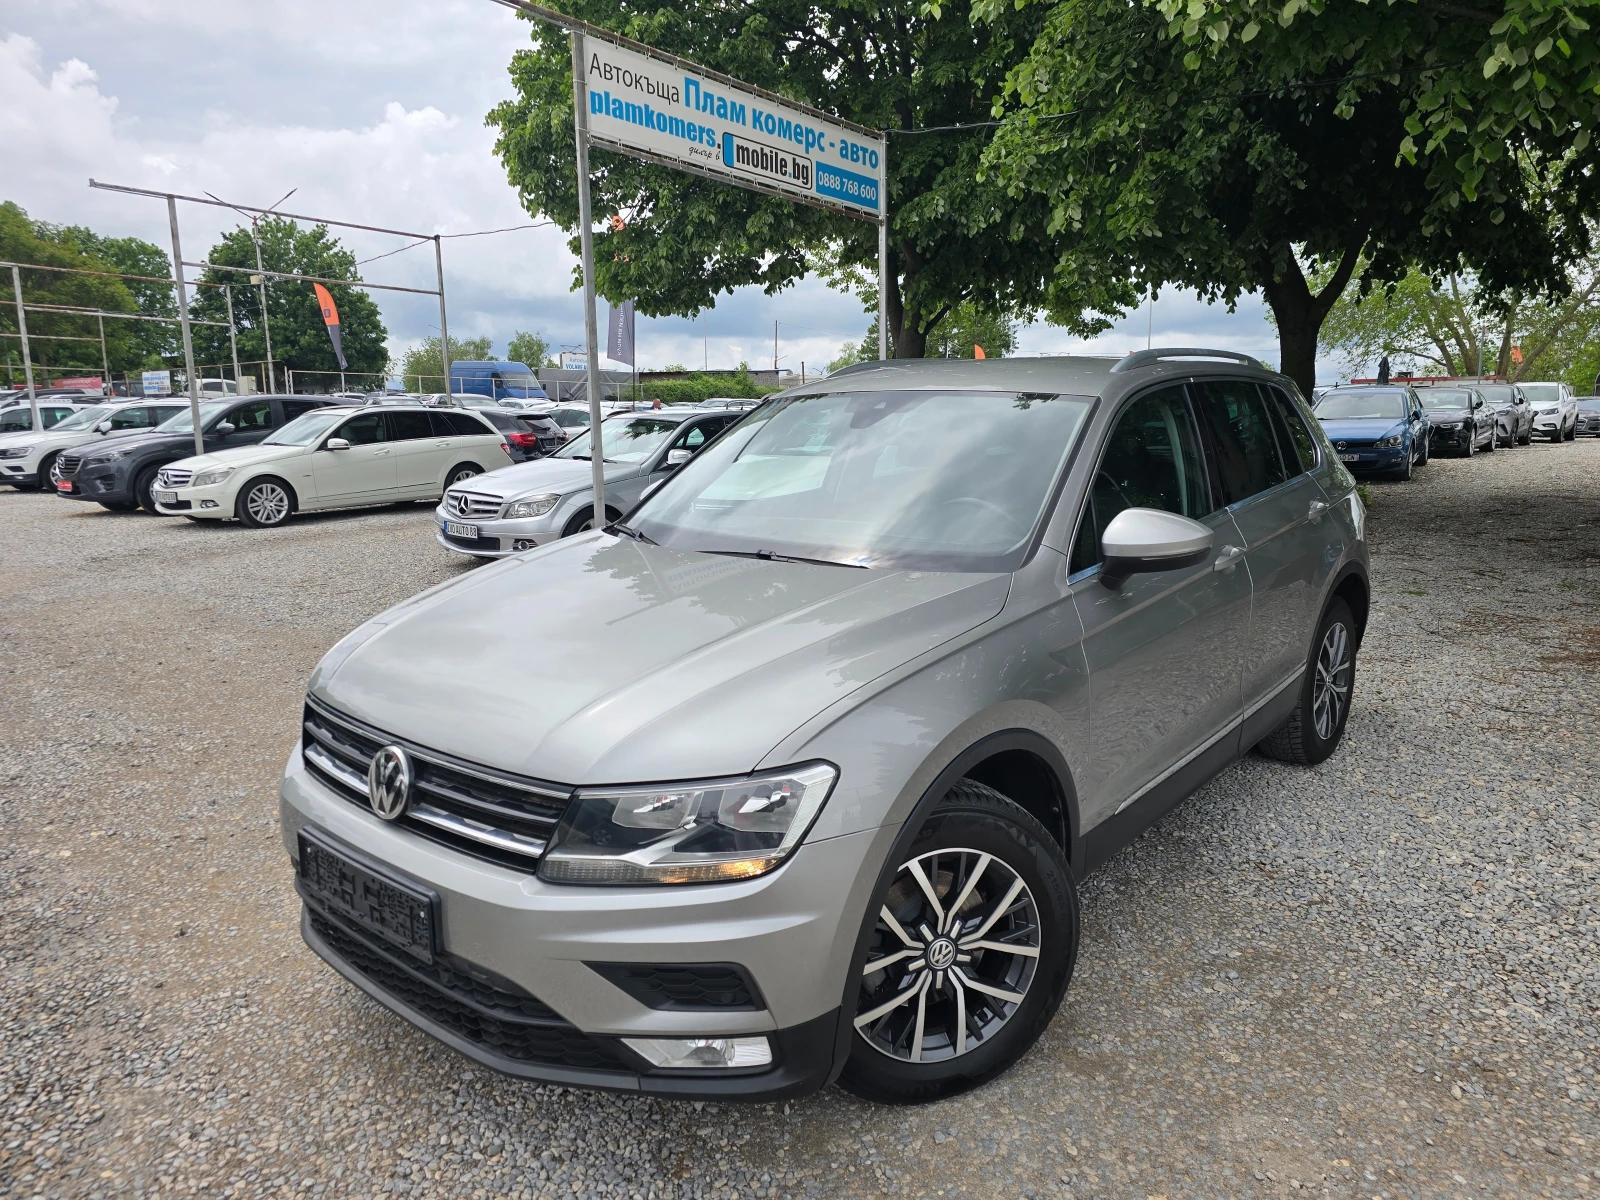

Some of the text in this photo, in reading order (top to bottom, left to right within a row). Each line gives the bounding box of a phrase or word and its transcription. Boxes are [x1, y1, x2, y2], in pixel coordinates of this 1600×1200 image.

[590, 53, 679, 105] Автокъща
[684, 76, 746, 126] Плам
[752, 108, 825, 155] комерс
[839, 139, 879, 169] авто
[736, 143, 809, 185] mobile.bg
[818, 171, 876, 201] 0888 768 600
